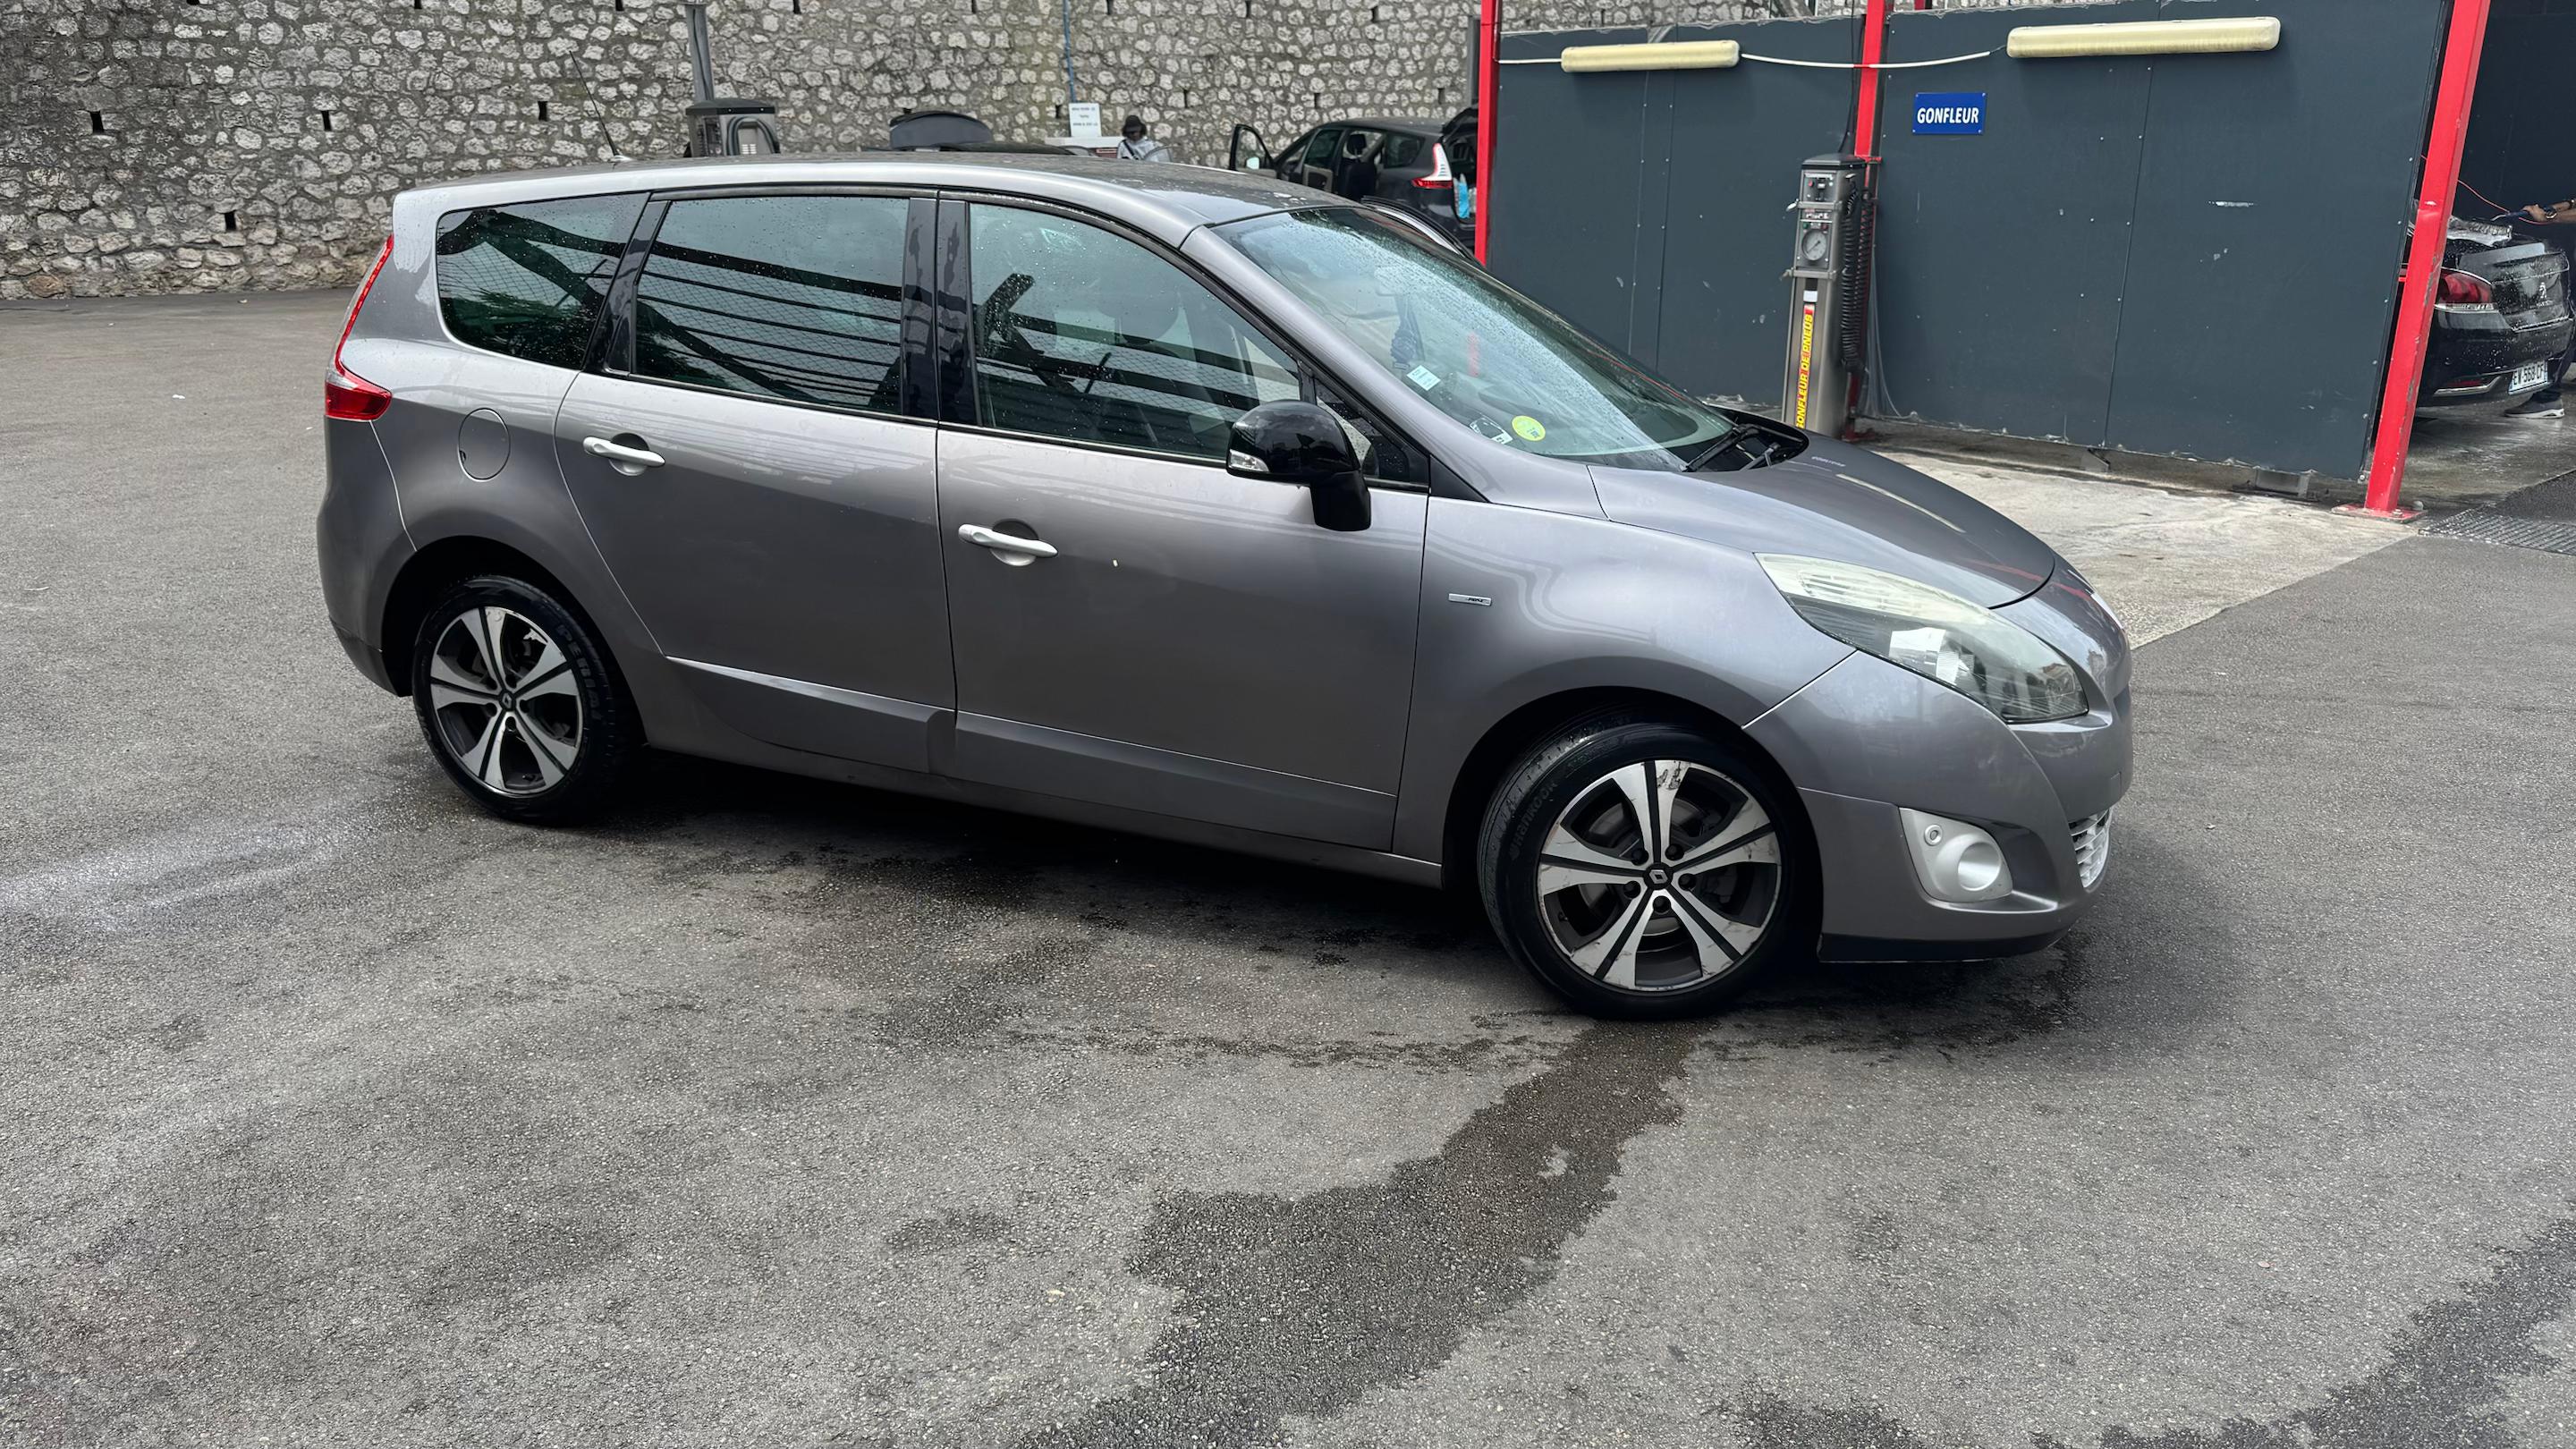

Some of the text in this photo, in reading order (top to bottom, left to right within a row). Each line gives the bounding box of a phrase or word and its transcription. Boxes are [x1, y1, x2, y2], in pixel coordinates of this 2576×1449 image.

[1917, 107, 1979, 123] GONFLEUR
[1802, 314, 1813, 353] PNEUS
[1801, 357, 1810, 371] DE
